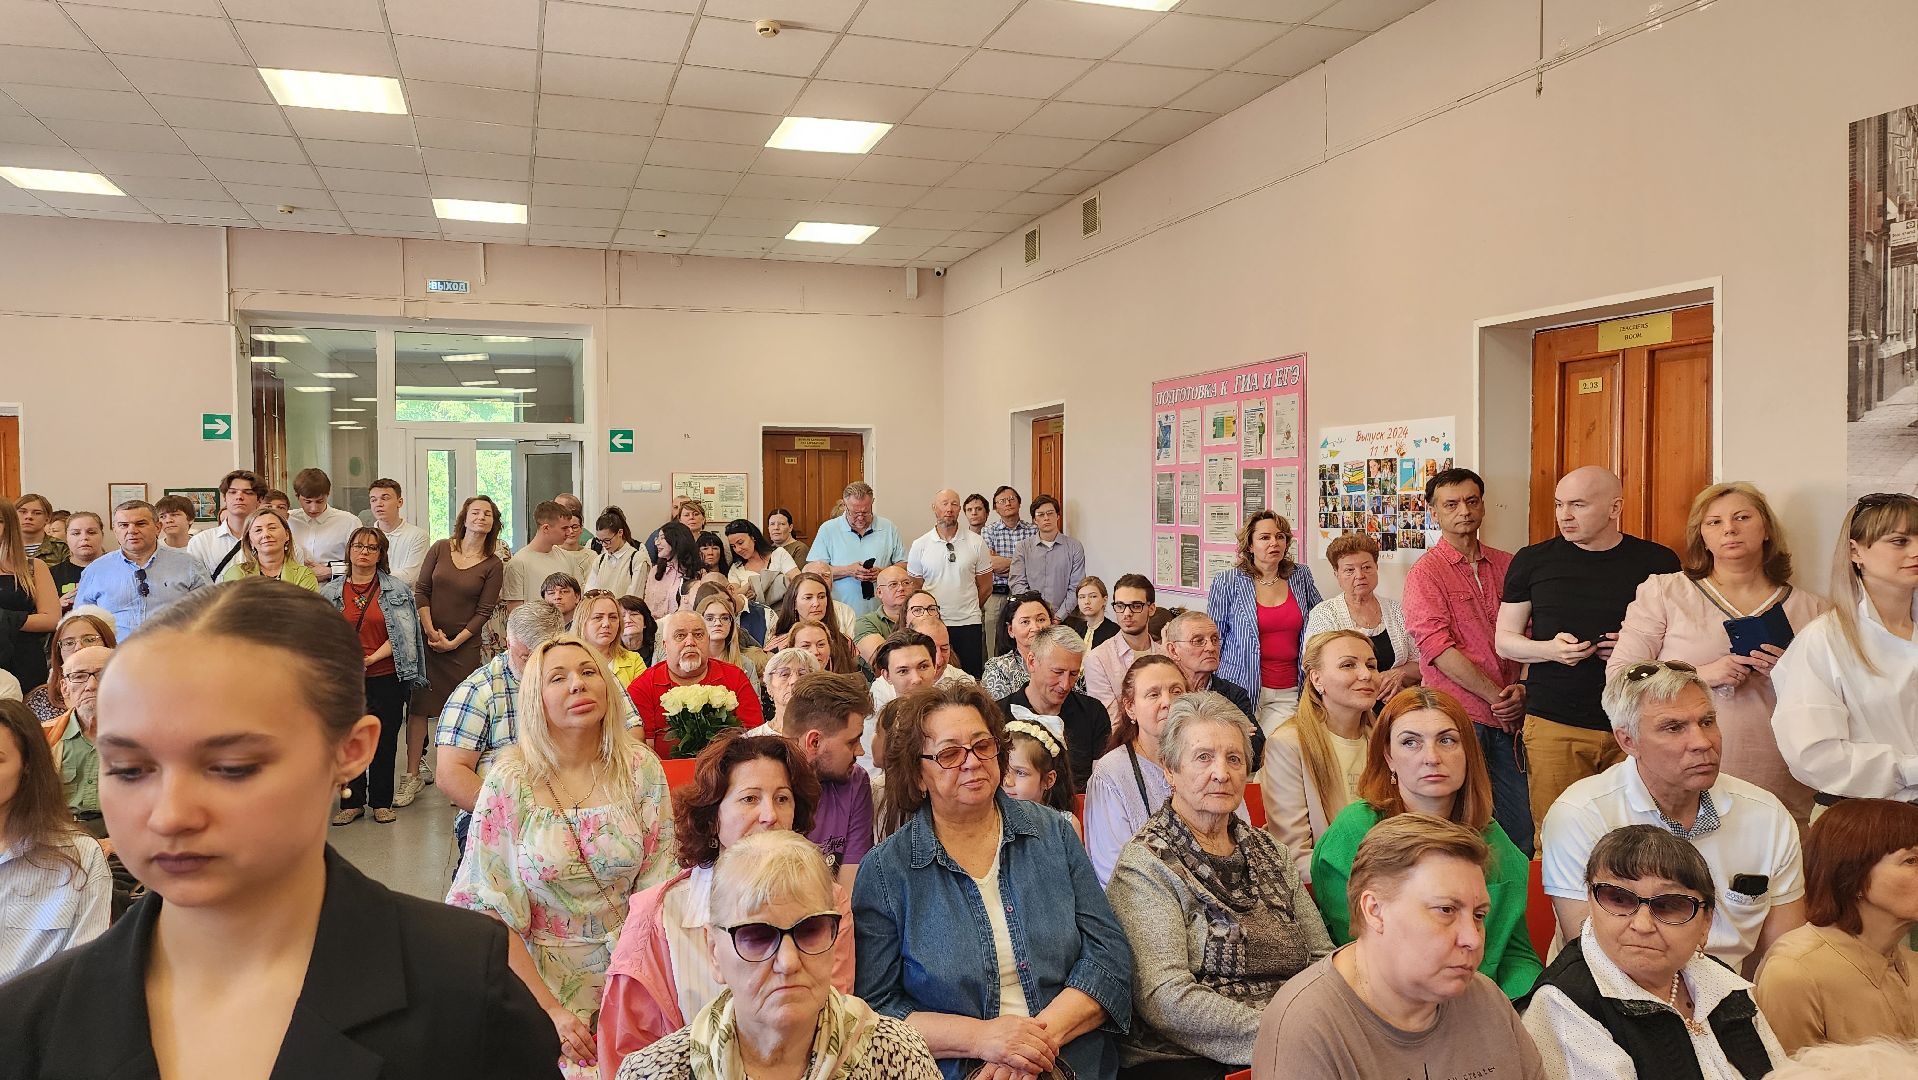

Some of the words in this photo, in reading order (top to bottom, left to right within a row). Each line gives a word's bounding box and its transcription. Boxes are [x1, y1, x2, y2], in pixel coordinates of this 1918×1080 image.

[431, 281, 466, 291] ВЫХОД
[1155, 383, 1217, 406] ПОДГОТОВКА
[1233, 373, 1259, 394] ГИА
[1274, 364, 1300, 388] ЕГЭ
[1355, 430, 1385, 444] Выпуск
[1387, 426, 1409, 440] 2024
